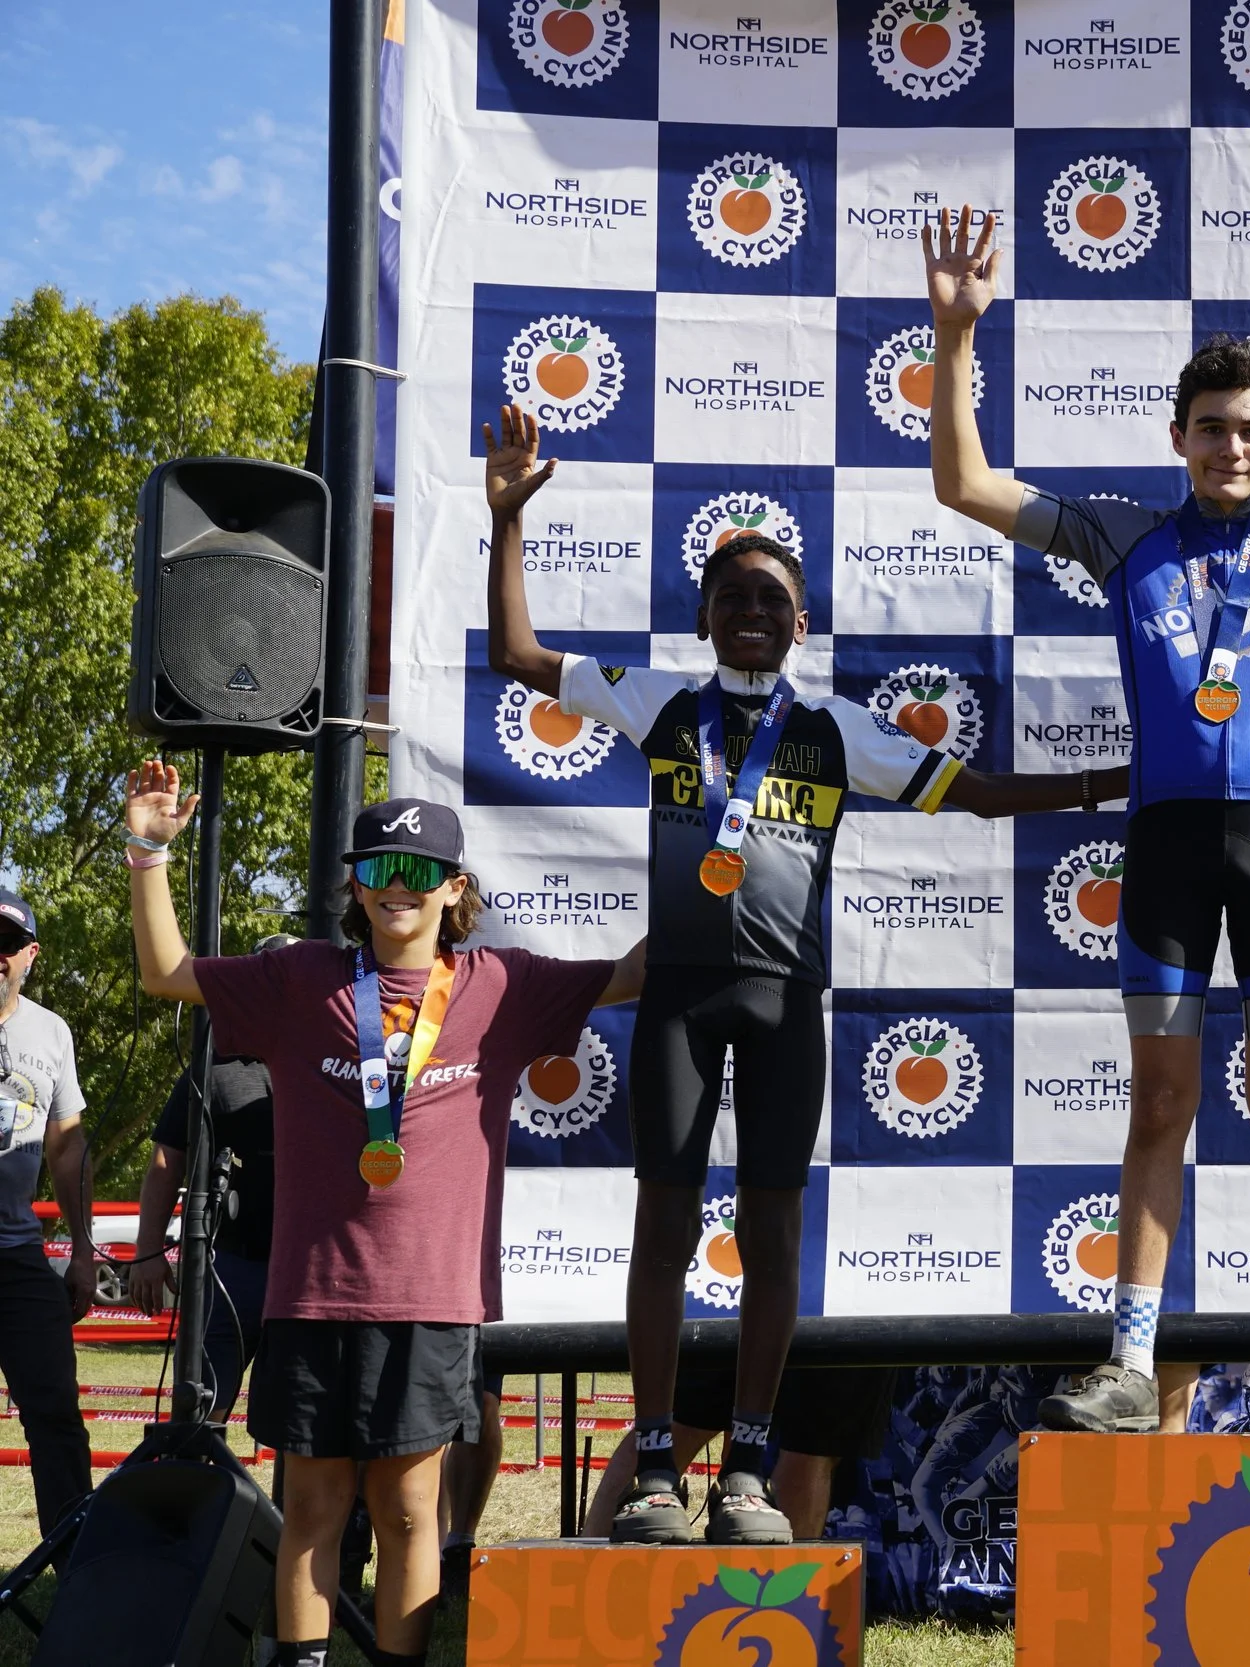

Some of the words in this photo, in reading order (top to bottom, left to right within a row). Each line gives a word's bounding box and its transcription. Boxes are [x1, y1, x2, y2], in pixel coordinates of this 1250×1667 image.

[543, 8, 621, 80] CYCLING
[670, 33, 828, 55] NORTHSIDE
[1025, 37, 1180, 55] NORTHSIDE
[699, 53, 798, 69] HOSPITAL
[901, 21, 977, 93] CYCLING
[1053, 58, 1151, 70] HOSPITAL
[486, 191, 647, 217] NORTHSIDE
[696, 159, 771, 230] GEORGIA
[1051, 163, 1126, 235] GEORGIA
[515, 214, 617, 230] HOSPITAL
[722, 188, 799, 259] CYCLING
[848, 208, 1004, 226] NORTHSDE
[1079, 190, 1154, 264] CYCLING
[511, 318, 588, 394] GEORGIA
[874, 333, 936, 404] GEORGI
[539, 350, 615, 425] CYCLING
[665, 376, 825, 398] NORTHSIDE
[1024, 384, 1178, 402] NORTHSIDE
[694, 398, 795, 411] HOSPITAL
[1054, 404, 1152, 416] HOSPITAL
[479, 538, 641, 559] NRTHSIDE
[845, 545, 1003, 562] NORTHSIDE
[524, 561, 611, 573] OSPITAL
[873, 565, 974, 576] HOSPITAL
[1190, 557, 1203, 600] GEORGIA
[764, 692, 784, 728] GEORGIA
[947, 701, 976, 760] LING
[1024, 723, 1133, 742] NORTHS
[531, 718, 610, 771] CYCLIN
[1053, 745, 1130, 757] HOSPIT
[705, 742, 714, 786] GEORGIA
[382, 806, 421, 835] A
[843, 896, 1003, 914] NORTHSIDE
[504, 913, 608, 925] HOSPITAL
[873, 917, 974, 928] HOSPITAL
[19, 1053, 53, 1077] KIDS
[871, 1024, 947, 1100] GEORGIA
[420, 1062, 481, 1087] CREEK
[529, 1054, 610, 1129] CYCLING
[898, 1053, 976, 1129] CYCLING
[1024, 1079, 1132, 1097] NORTHS
[1054, 1100, 1130, 1111] HOSPIT
[500, 1246, 629, 1263] ORTHSIDE
[838, 1250, 1001, 1268] NORTHSIDE
[867, 1271, 970, 1282] HOSPITAL
[90, 1311, 151, 1321] SPECIALIZED
[90, 1386, 142, 1396] SPECIALIZED
[636, 1430, 673, 1450] ide
[732, 1420, 770, 1446] Rid
